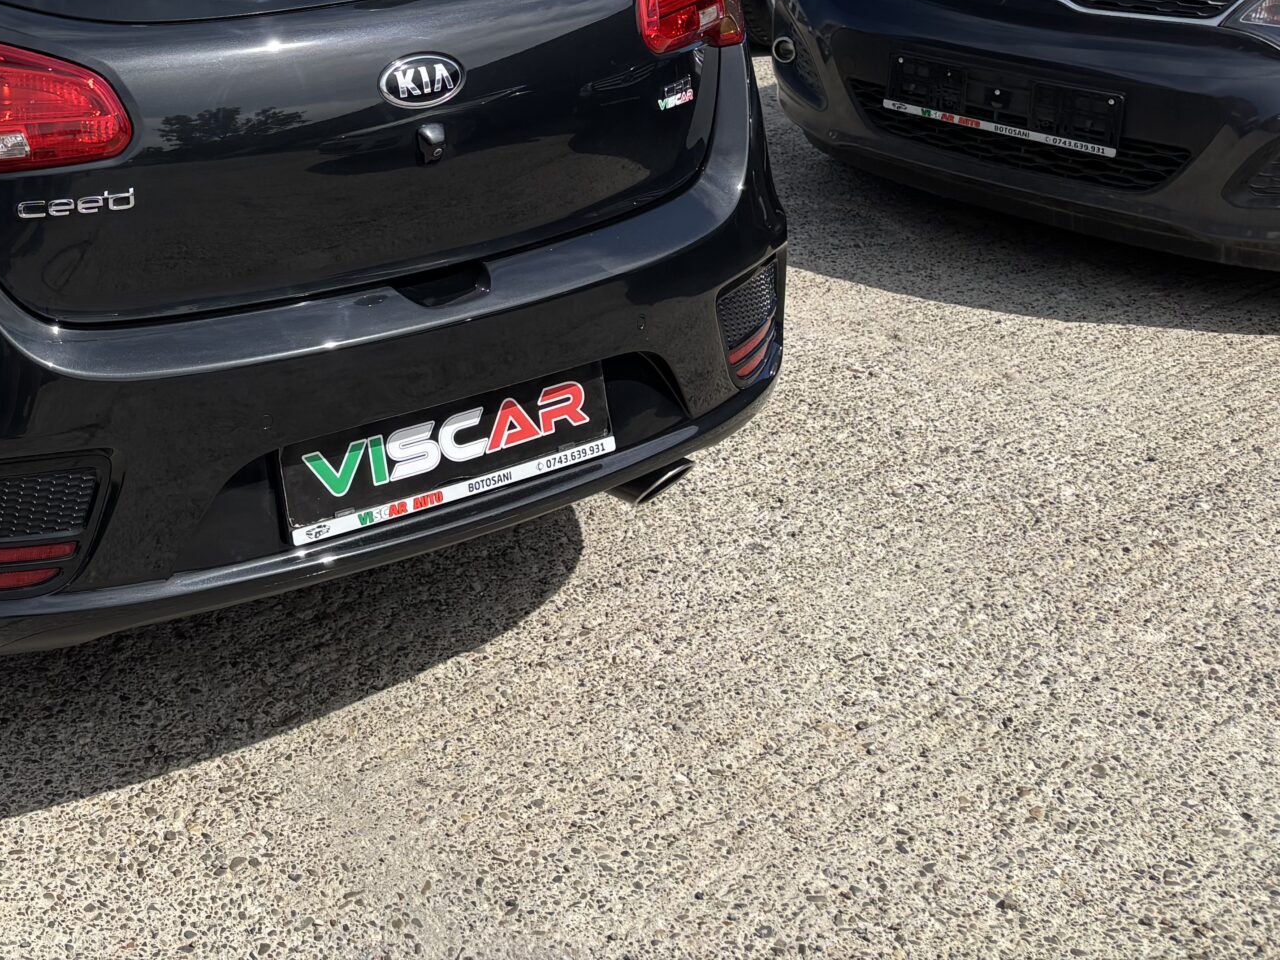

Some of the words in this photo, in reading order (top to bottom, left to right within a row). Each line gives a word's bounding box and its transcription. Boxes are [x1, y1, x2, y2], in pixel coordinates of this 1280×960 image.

[393, 63, 454, 98] KIA
[994, 125, 1030, 138] BOTOSANI
[1052, 138, 1105, 154] 0743.639.931
[301, 380, 590, 497] VISCAR
[467, 471, 513, 493] BOTOSANI
[545, 442, 606, 469] 0743.639.931
[357, 501, 408, 526] VISCAR
[413, 490, 444, 510] AUTO
